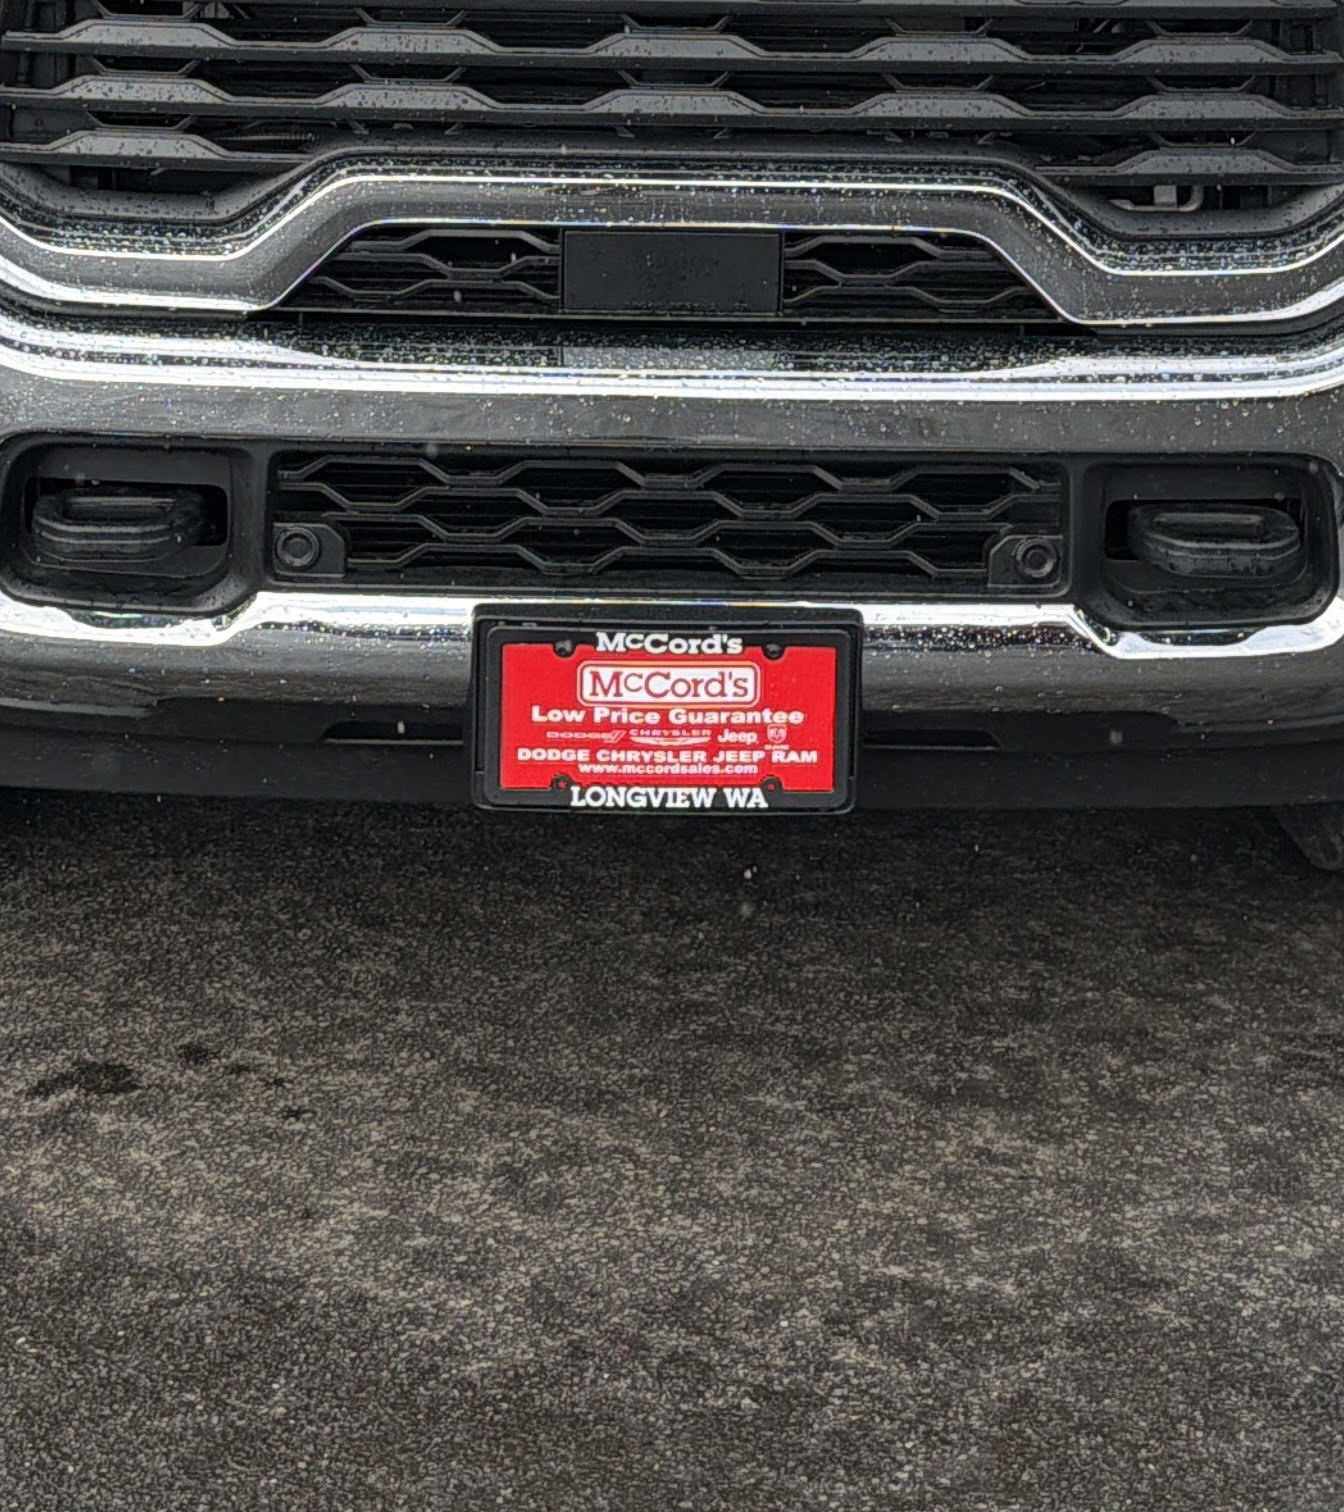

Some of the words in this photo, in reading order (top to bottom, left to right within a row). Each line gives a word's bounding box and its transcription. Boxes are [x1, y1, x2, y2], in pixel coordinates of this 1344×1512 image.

[596, 632, 743, 654] McCord's
[589, 671, 749, 699] McCord's
[531, 706, 585, 723] Low
[593, 707, 661, 724] Price
[668, 707, 805, 724] Guarantee
[718, 728, 758, 745] Jeep
[517, 748, 590, 761] DODGE
[596, 749, 707, 763] CHRYSLER
[713, 750, 766, 763] JEEP
[771, 750, 818, 763] RAM
[578, 762, 759, 775] www.mccordsales.com
[570, 786, 717, 808] LONGVIEW
[723, 787, 769, 809] WA
